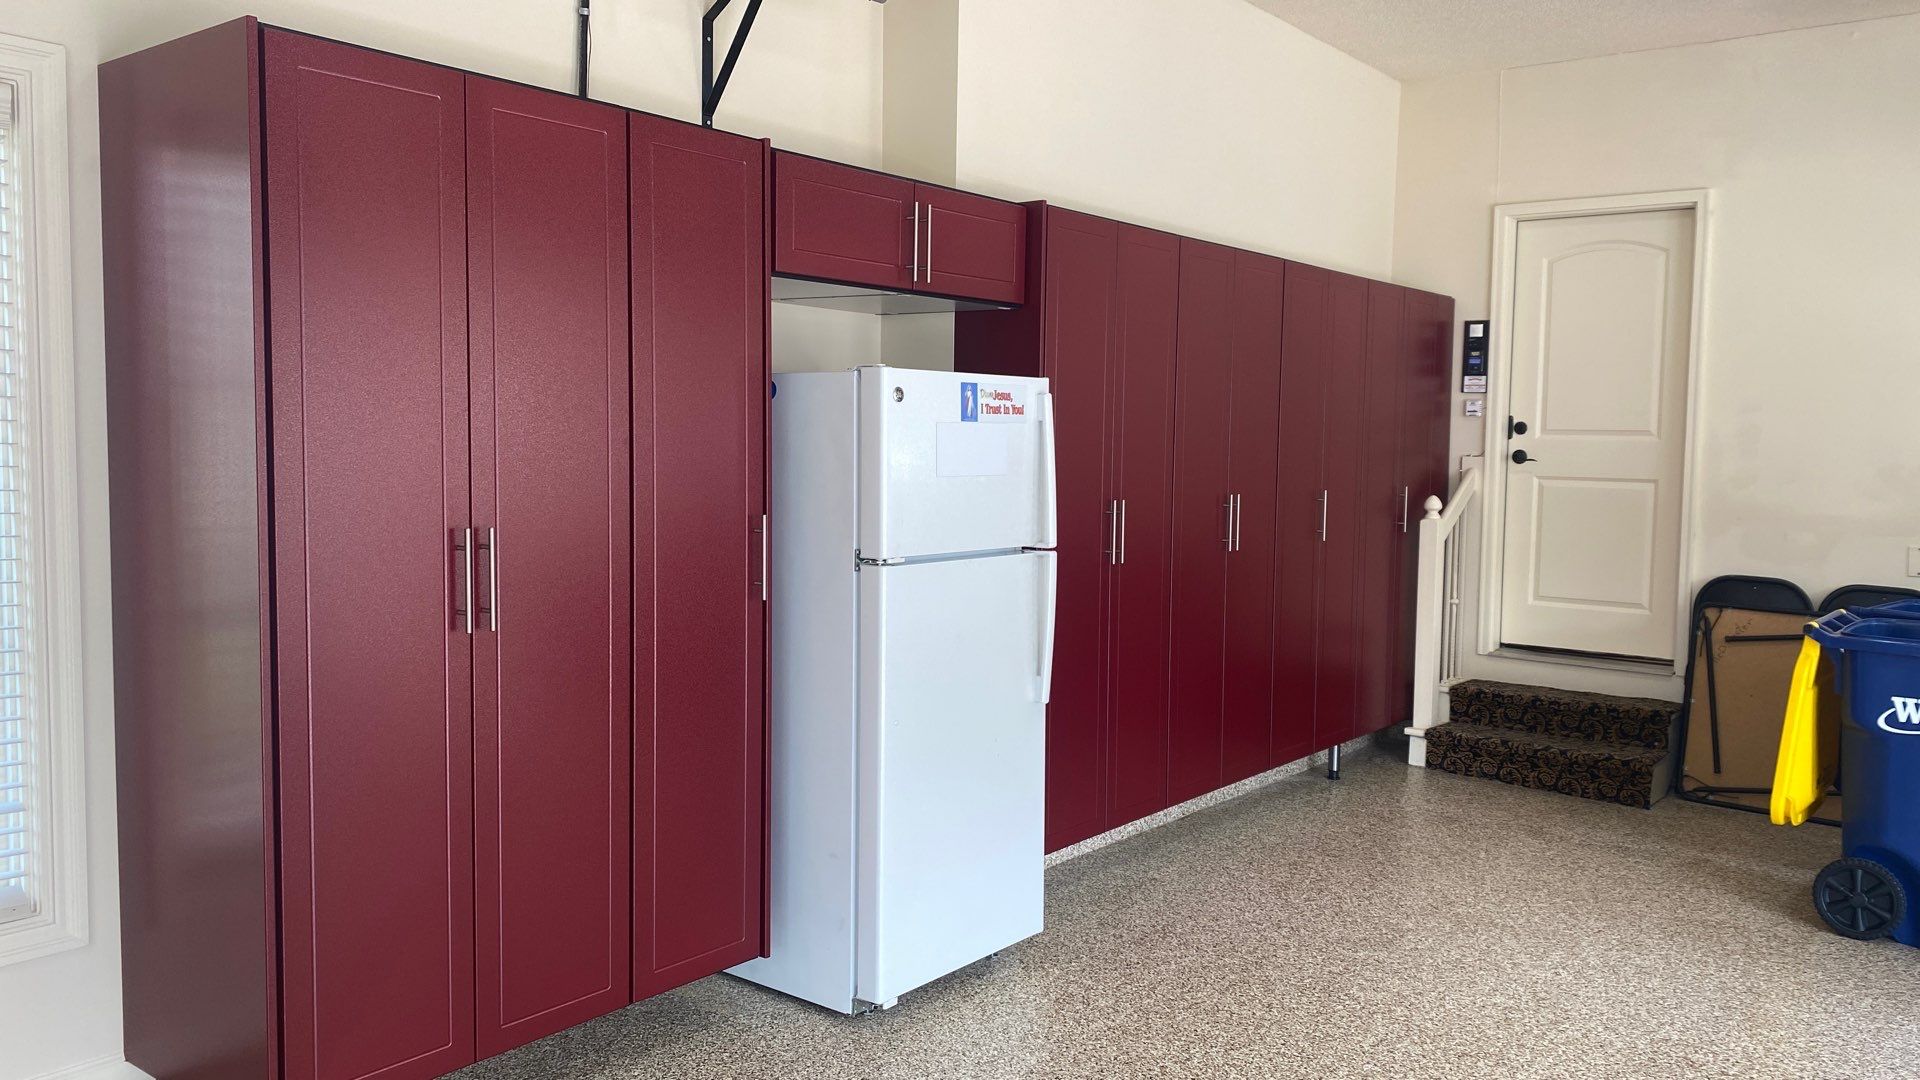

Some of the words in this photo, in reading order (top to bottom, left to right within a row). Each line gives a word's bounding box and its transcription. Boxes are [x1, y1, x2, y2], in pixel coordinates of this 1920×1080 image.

[993, 390, 1013, 402] Jesus,
[981, 404, 984, 414] I
[985, 404, 1002, 414] Trust
